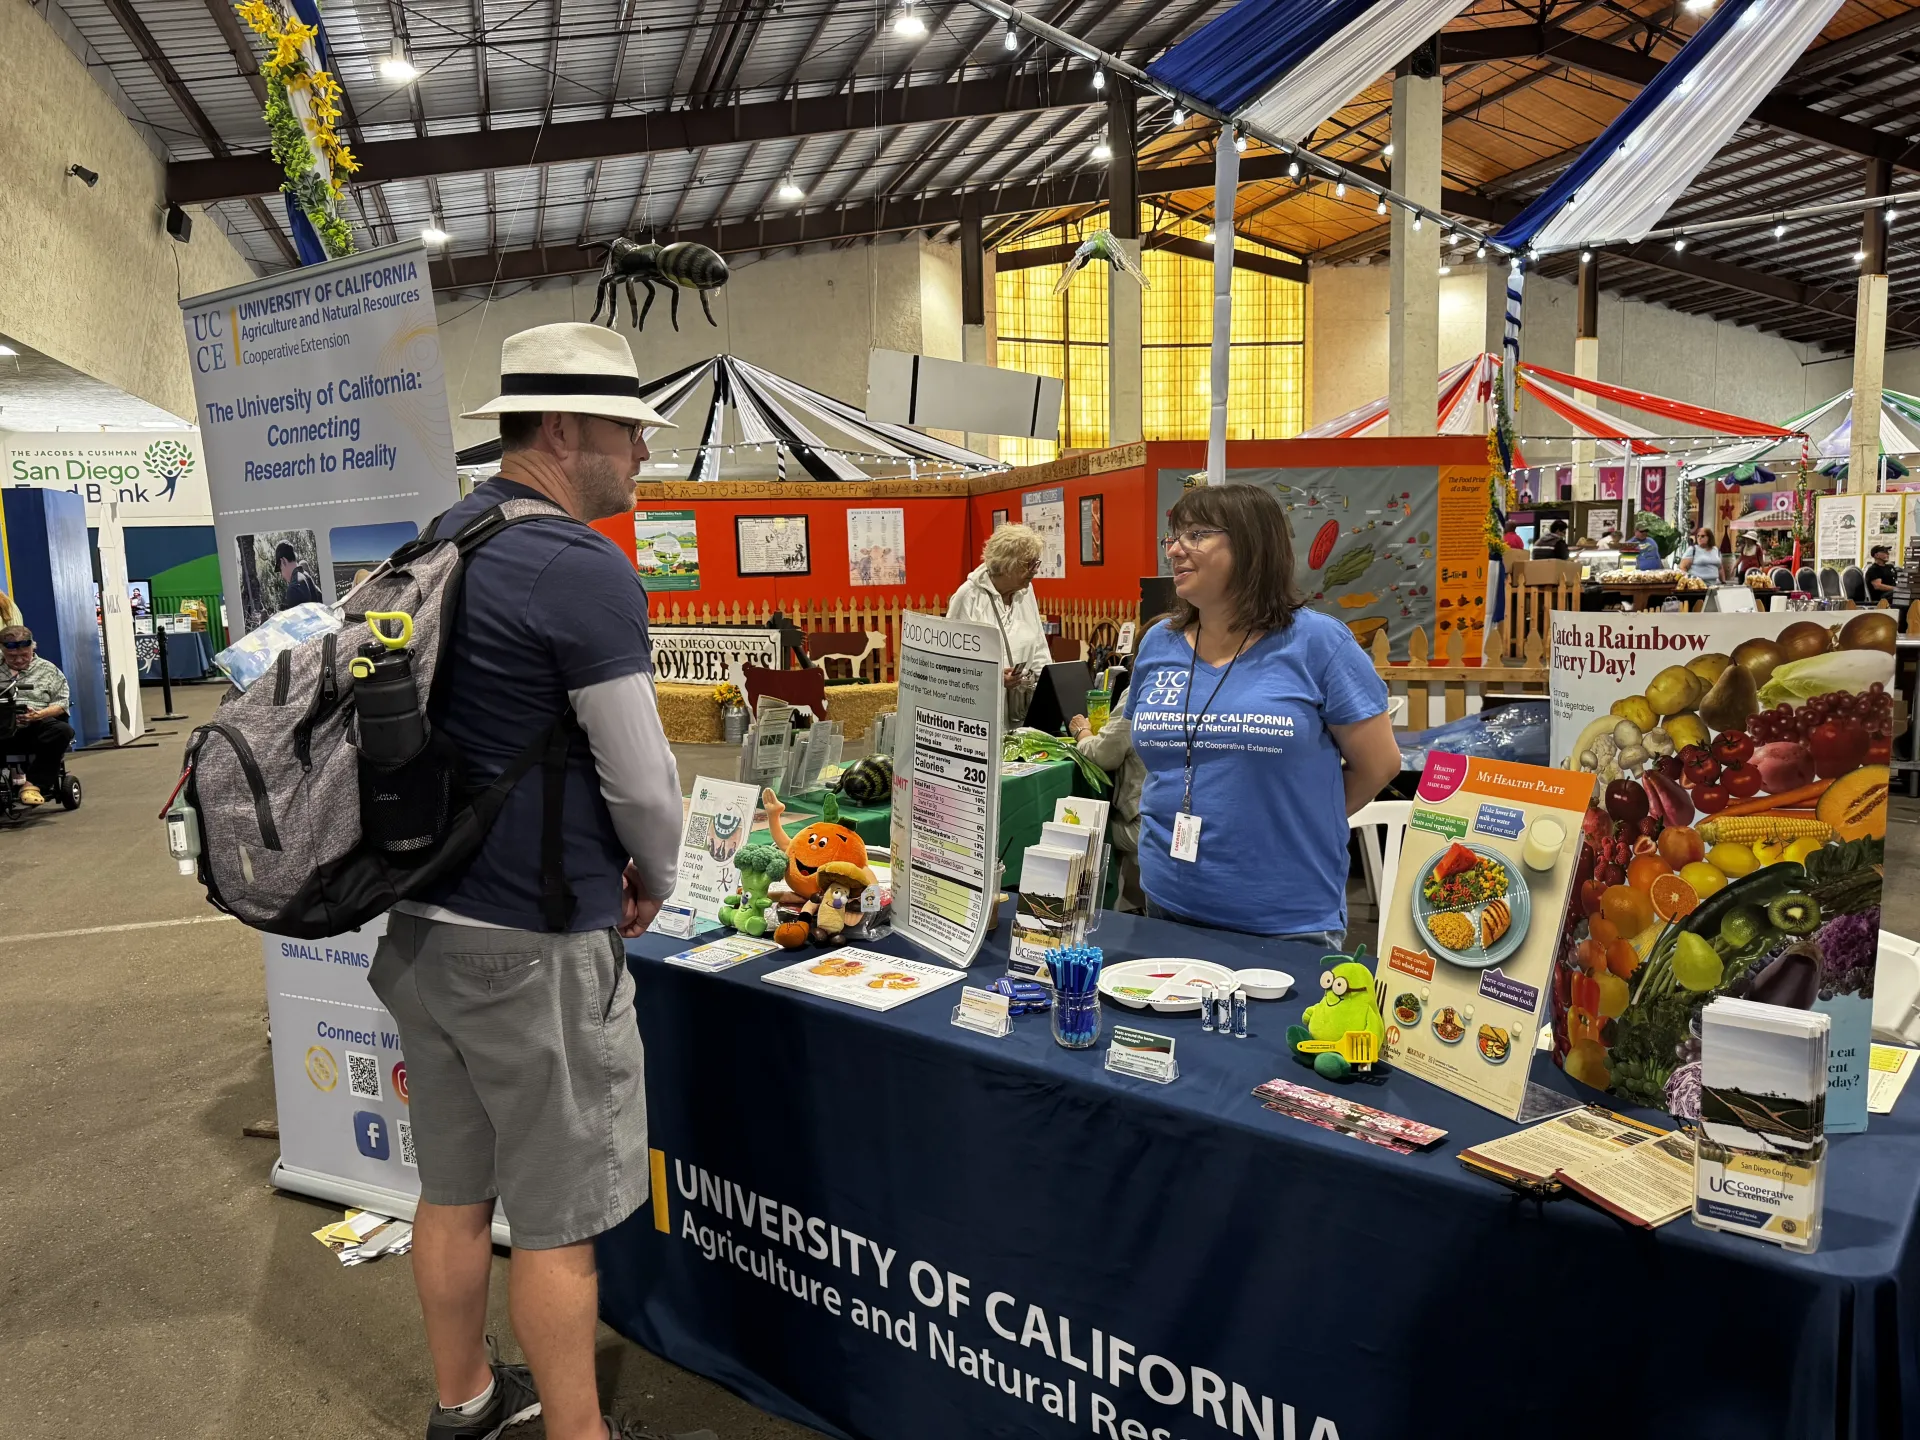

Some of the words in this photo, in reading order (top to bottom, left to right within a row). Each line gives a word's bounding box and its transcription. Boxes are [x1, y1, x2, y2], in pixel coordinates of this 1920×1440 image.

[238, 286, 311, 320] UNIVERSITY
[315, 283, 332, 302] OF
[335, 261, 417, 297] CALIFORNIA
[241, 313, 298, 341] Agriculture
[300, 310, 319, 327] and
[322, 300, 361, 323] Natural
[363, 289, 419, 314] Resources
[192, 310, 223, 341] UC
[197, 342, 226, 373] CE
[243, 342, 299, 365] Cooperative
[301, 331, 350, 353] Extension
[206, 402, 233, 424] The
[237, 387, 311, 419] University
[317, 382, 333, 405] of
[338, 368, 422, 402] California:
[267, 415, 360, 447] Connecting
[12, 460, 59, 480] San
[66, 460, 139, 484] Diego
[244, 453, 315, 482] Research
[320, 451, 336, 473] to
[342, 444, 397, 471] Reality
[86, 483, 150, 503] Bnk
[655, 638, 678, 649] SAN
[680, 638, 715, 650] DIEGO
[718, 640, 767, 650] COUNTY
[924, 628, 981, 652] CHOICES
[1553, 622, 1581, 647] Catch
[1586, 632, 1595, 647] a
[1598, 625, 1711, 651] Rainbow
[1554, 646, 1587, 679] Every
[1589, 650, 1636, 683] Day!
[949, 679, 960, 688] that
[962, 681, 979, 691] offers
[1156, 671, 1189, 688] UC
[1147, 689, 1181, 705] CE
[917, 710, 954, 730] Nutrition
[958, 720, 987, 737] Facts
[1138, 722, 1183, 732] Agriculture
[1206, 724, 1239, 733] Natural
[1243, 726, 1294, 737] Resources
[1139, 712, 1201, 722] UNIVERSITY
[1202, 714, 1217, 722] OF
[1220, 714, 1294, 727] CALIFORNIA
[1205, 742, 1245, 750] Cooperative
[1248, 744, 1282, 754] Extension
[916, 756, 944, 773] Calories
[964, 767, 986, 784] 230
[1493, 774, 1534, 790] HEALTHY
[1535, 780, 1565, 795] PLATE
[1444, 815, 1456, 824] plate
[1481, 805, 1494, 813] Make
[1495, 807, 1508, 816] lower
[1433, 822, 1457, 833] vegetables.
[1492, 826, 1503, 834] your
[1504, 828, 1517, 836] meal.
[682, 861, 693, 870] CODE
[694, 863, 703, 871] FOR
[685, 852, 695, 861] SCAN
[688, 891, 720, 904] INFORMATION
[690, 883, 712, 893] PROGRAM
[281, 942, 323, 961] SMALL
[326, 949, 370, 968] FARMS
[1016, 947, 1027, 957] UC
[1393, 950, 1405, 958] Serve
[1413, 958, 1427, 966] corner
[891, 954, 954, 977] Distortion
[1402, 961, 1414, 970] whole
[1415, 965, 1430, 976] grains.
[1482, 983, 1499, 995] healthy
[1500, 990, 1518, 1002] protein
[1519, 996, 1534, 1008] foods.
[1484, 975, 1497, 984] Serve
[1507, 983, 1522, 994] corner
[1523, 988, 1535, 998] with
[317, 1021, 376, 1046] Connect
[1837, 1048, 1856, 1057] eat
[1741, 1161, 1752, 1171] San
[1753, 1164, 1771, 1176] Diego
[1773, 1167, 1793, 1180] County
[1710, 1176, 1736, 1196] UC
[1737, 1182, 1793, 1201] Cooperative
[1737, 1190, 1780, 1206] Extension
[1709, 1204, 1731, 1214] University
[1736, 1209, 1758, 1219] California
[674, 1158, 896, 1288] UNIVERSITY
[909, 1260, 970, 1318] OF
[682, 1210, 842, 1316] Agriculture
[851, 1298, 918, 1351] and
[928, 1321, 1076, 1424] Natural
